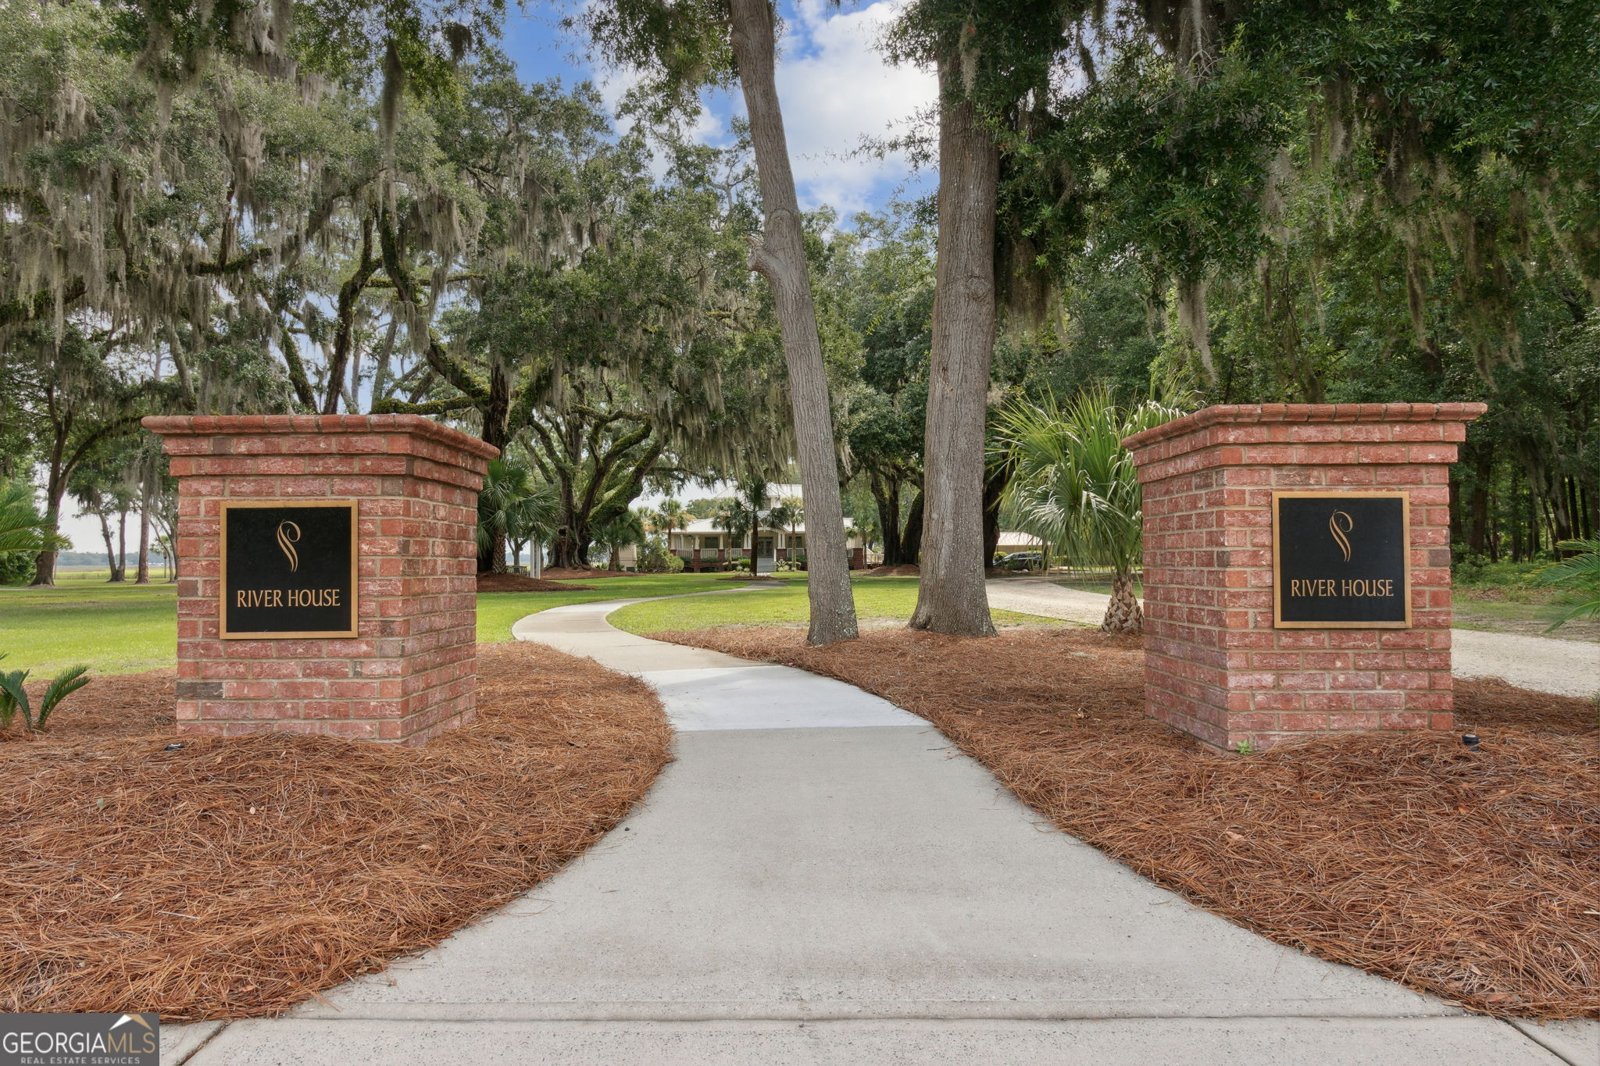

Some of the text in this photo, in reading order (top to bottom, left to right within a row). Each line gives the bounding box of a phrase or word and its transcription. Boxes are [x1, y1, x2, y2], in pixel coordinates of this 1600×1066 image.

[1291, 579, 1395, 597] RIVER HOUSE
[237, 588, 341, 608] RIVER HOUSE
